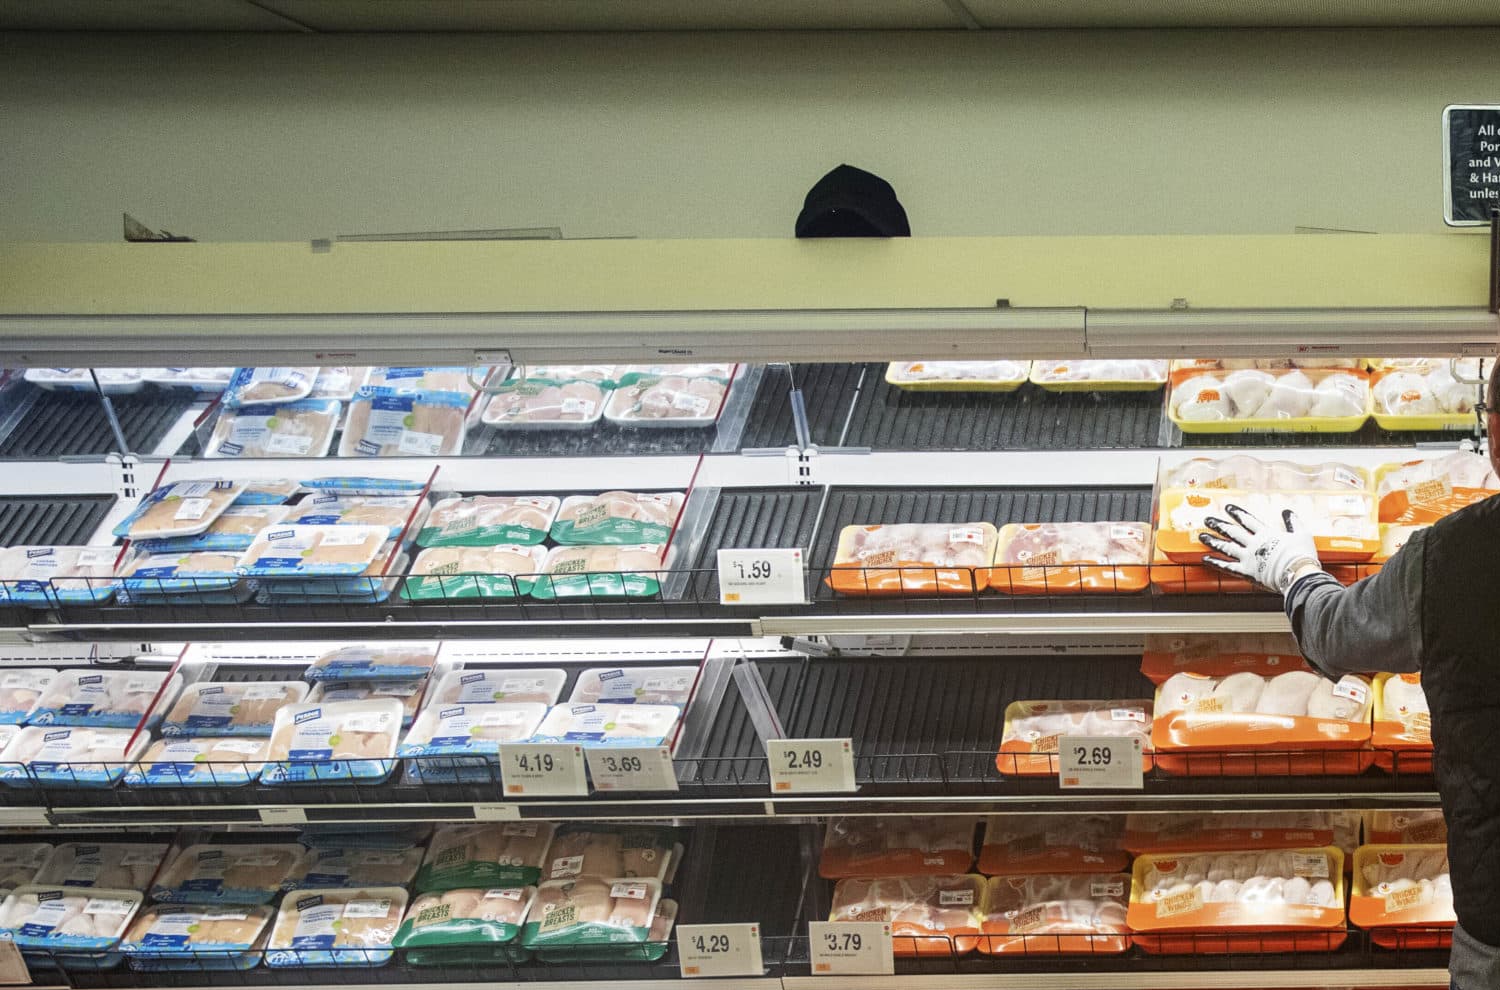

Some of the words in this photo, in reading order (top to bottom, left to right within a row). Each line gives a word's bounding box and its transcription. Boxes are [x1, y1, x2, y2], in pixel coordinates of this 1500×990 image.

[1478, 125, 1494, 136] All
[1469, 157, 1491, 167] and
[1470, 173, 1479, 183] &
[515, 753, 554, 771] $4.19
[602, 756, 642, 772] $3.69
[783, 750, 823, 769] $2.49
[1073, 747, 1111, 765] $2.69
[544, 913, 575, 927] BREASTS
[547, 906, 576, 920] CHICKEN
[692, 934, 730, 952] $4.29
[824, 933, 862, 951] $3.79
